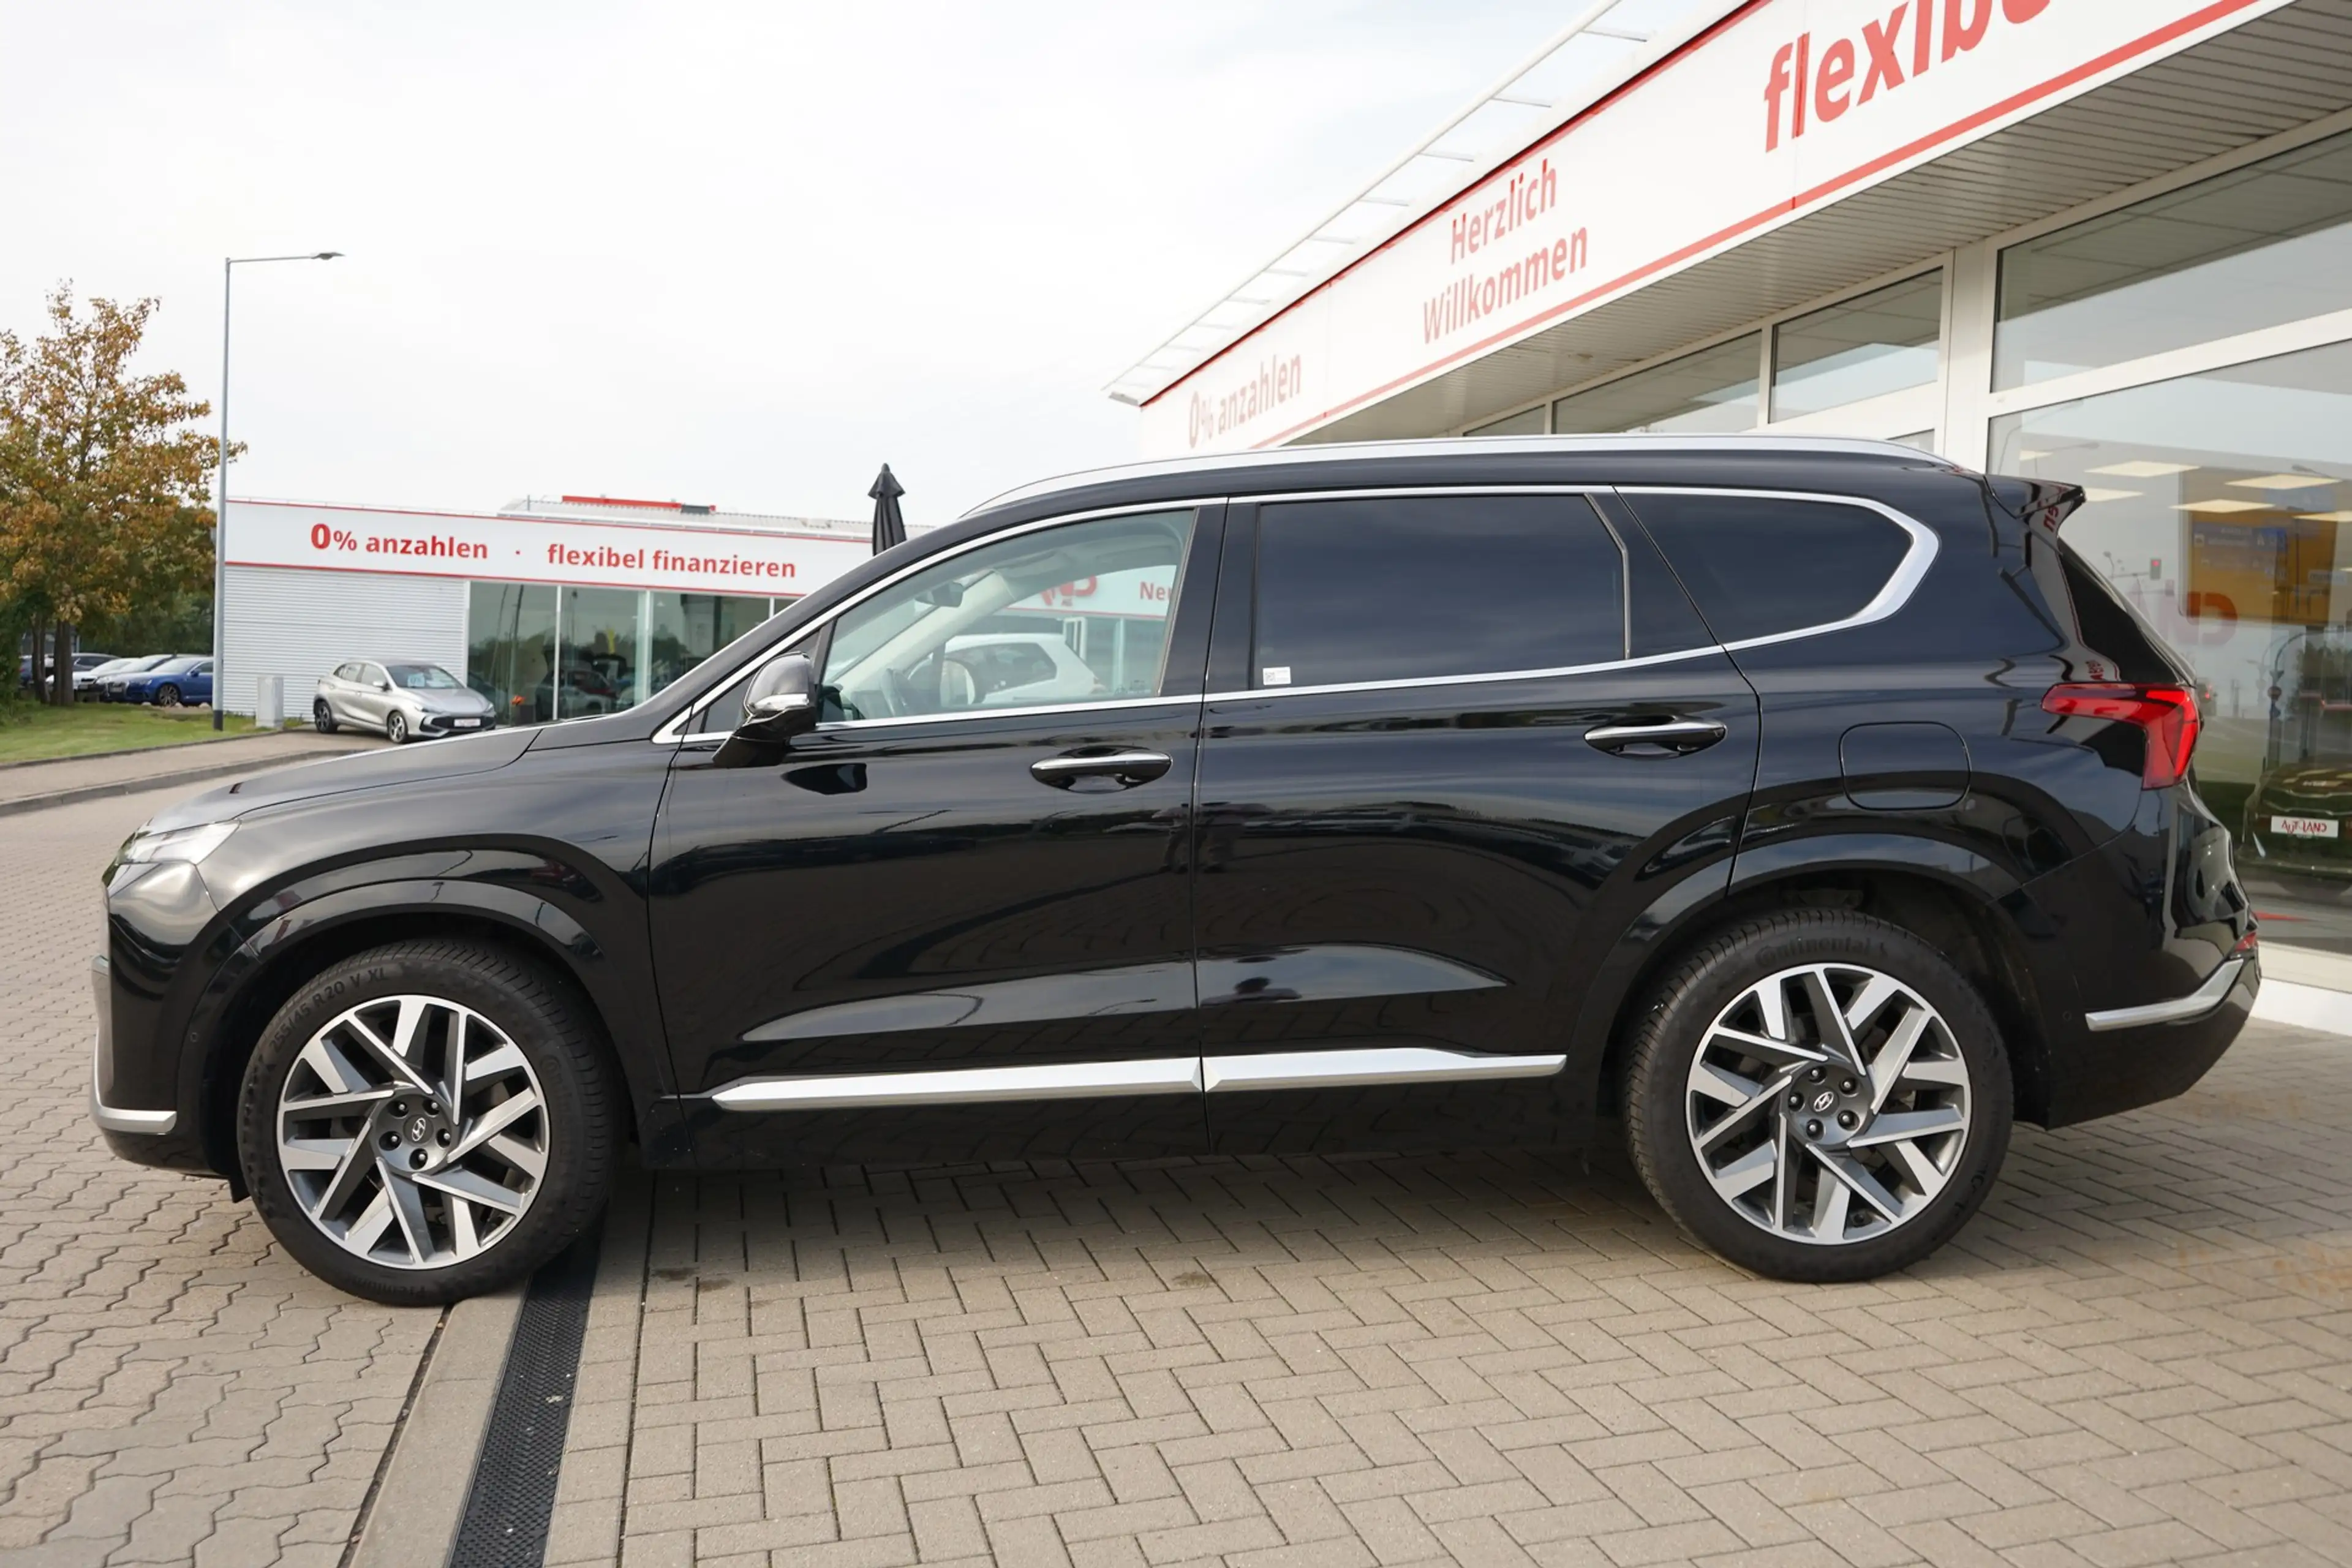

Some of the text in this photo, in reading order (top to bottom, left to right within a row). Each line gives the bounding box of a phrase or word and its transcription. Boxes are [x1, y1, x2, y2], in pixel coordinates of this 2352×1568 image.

[1451, 158, 1556, 265] Herzlich
[1424, 227, 1587, 345] Willkommen
[1189, 353, 1301, 449] 0% anzahlen
[311, 523, 796, 578] 0% anzahlen flexibel finanzieren
